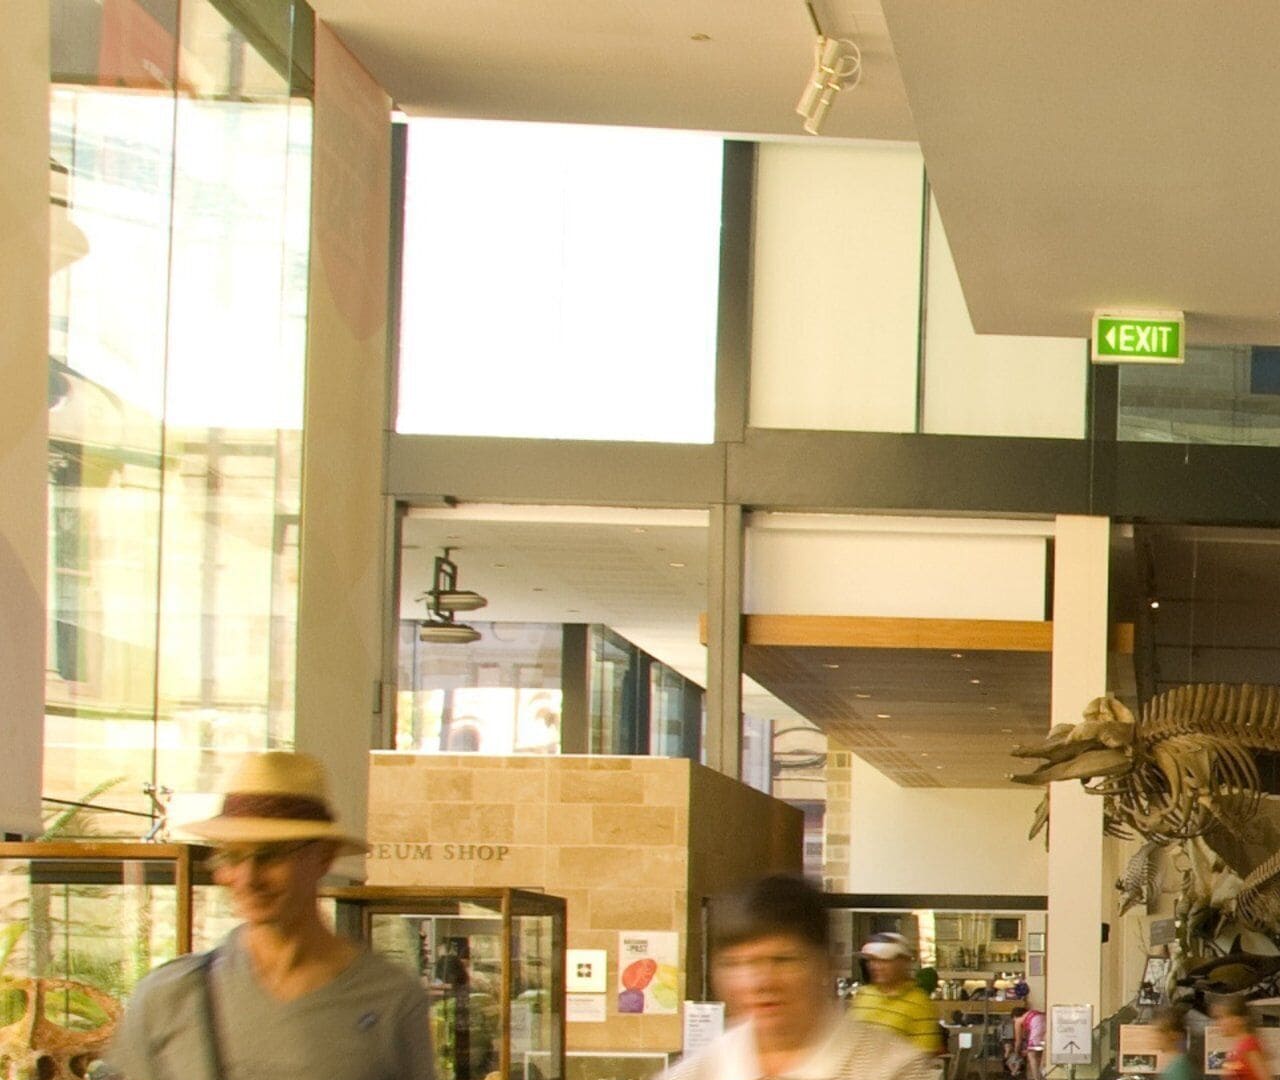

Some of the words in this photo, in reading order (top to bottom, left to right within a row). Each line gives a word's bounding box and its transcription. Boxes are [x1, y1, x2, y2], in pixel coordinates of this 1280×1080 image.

[1119, 324, 1172, 353] EXIT
[366, 843, 433, 861] SEUM
[443, 844, 509, 861] SHOP
